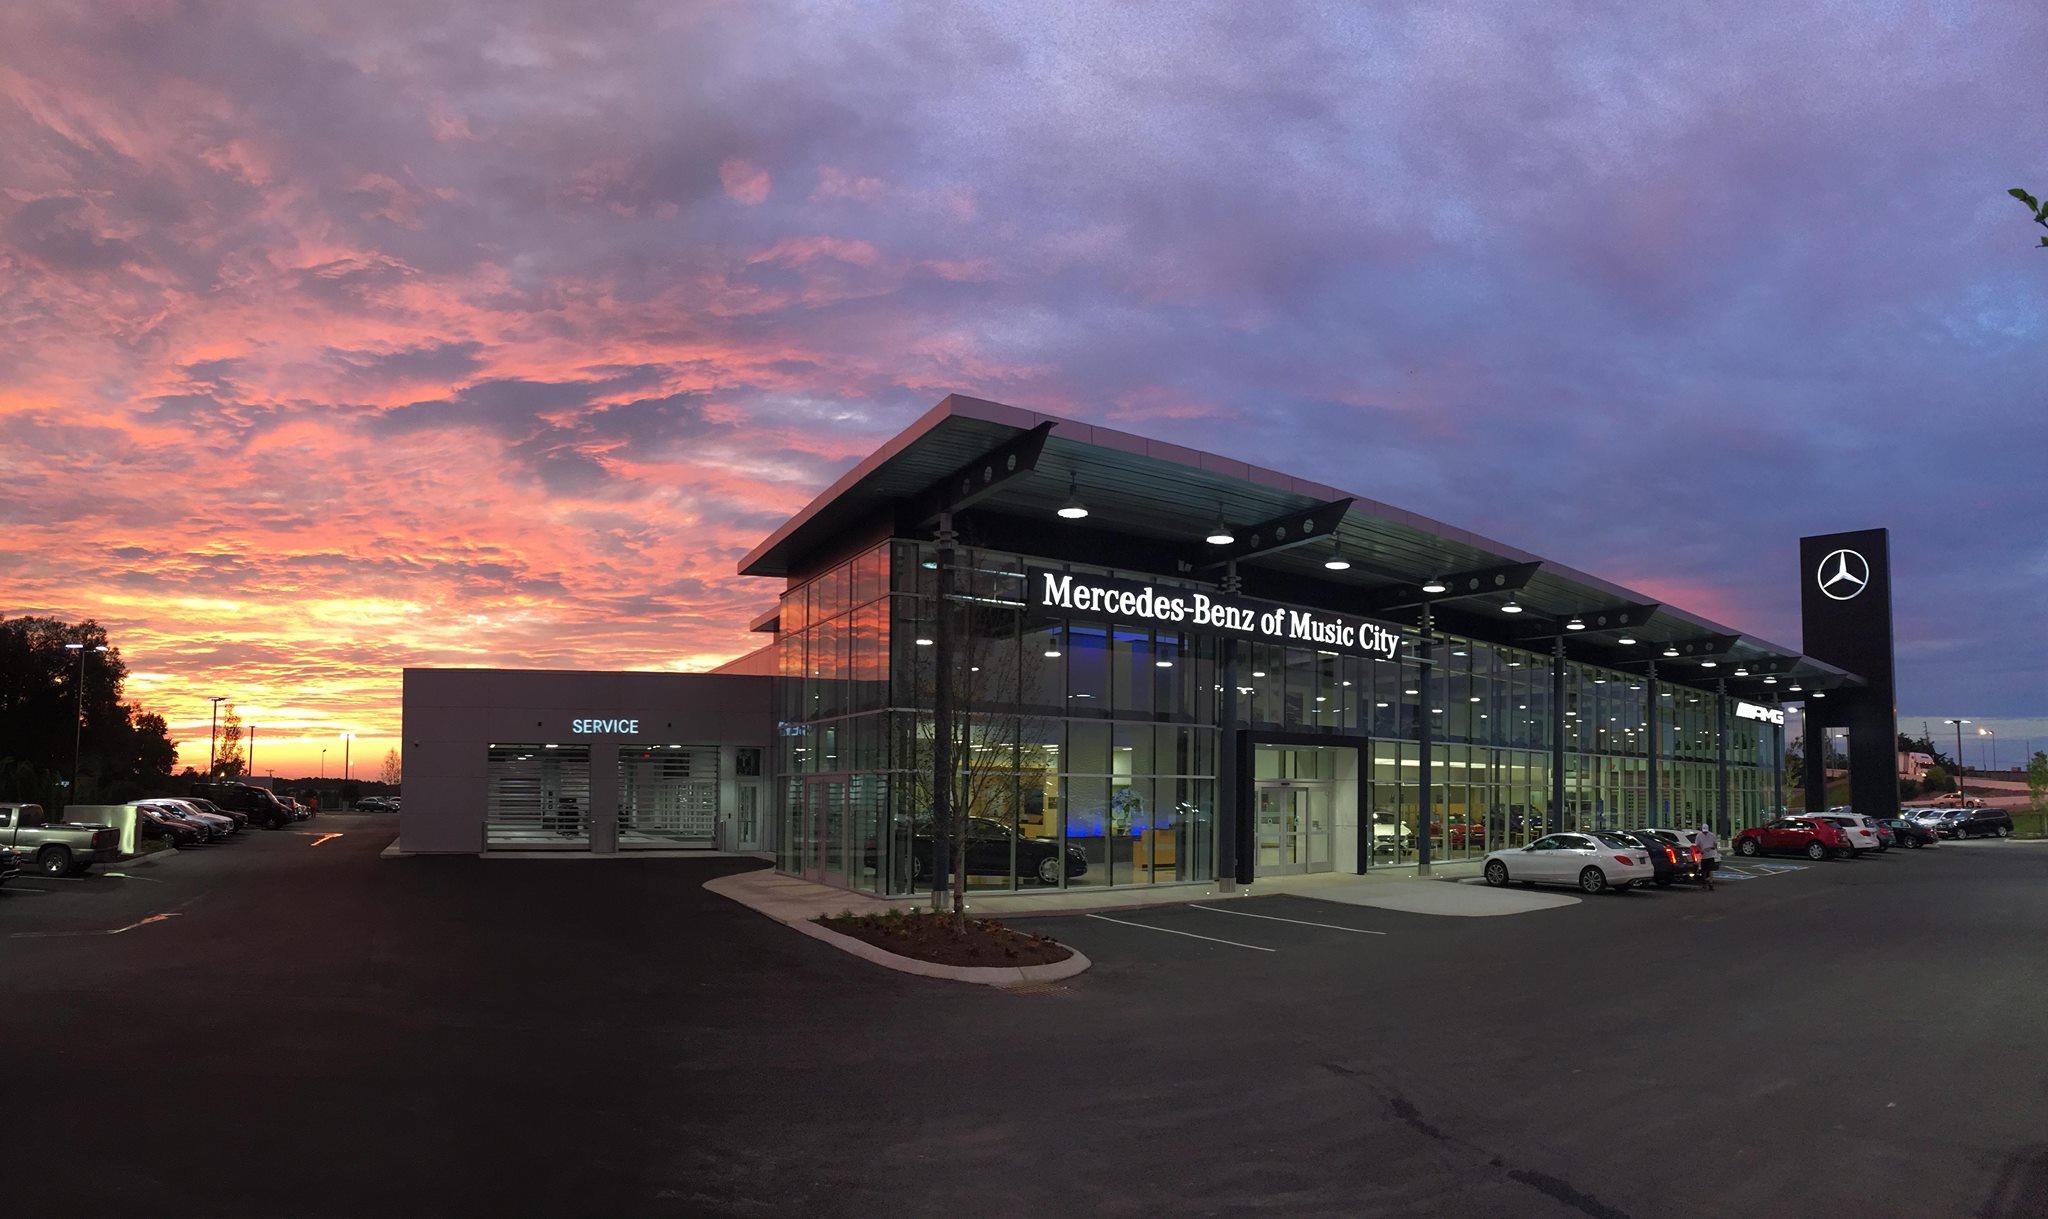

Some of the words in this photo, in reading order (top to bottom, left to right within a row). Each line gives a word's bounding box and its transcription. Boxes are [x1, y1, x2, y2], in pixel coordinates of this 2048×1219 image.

[1042, 572, 1255, 632] Mercedes-Benz
[1260, 608, 1286, 637] of
[1288, 610, 1354, 647] Music
[1359, 622, 1400, 660] City
[1749, 704, 1785, 725] AMG
[572, 718, 640, 735] SERVICE
